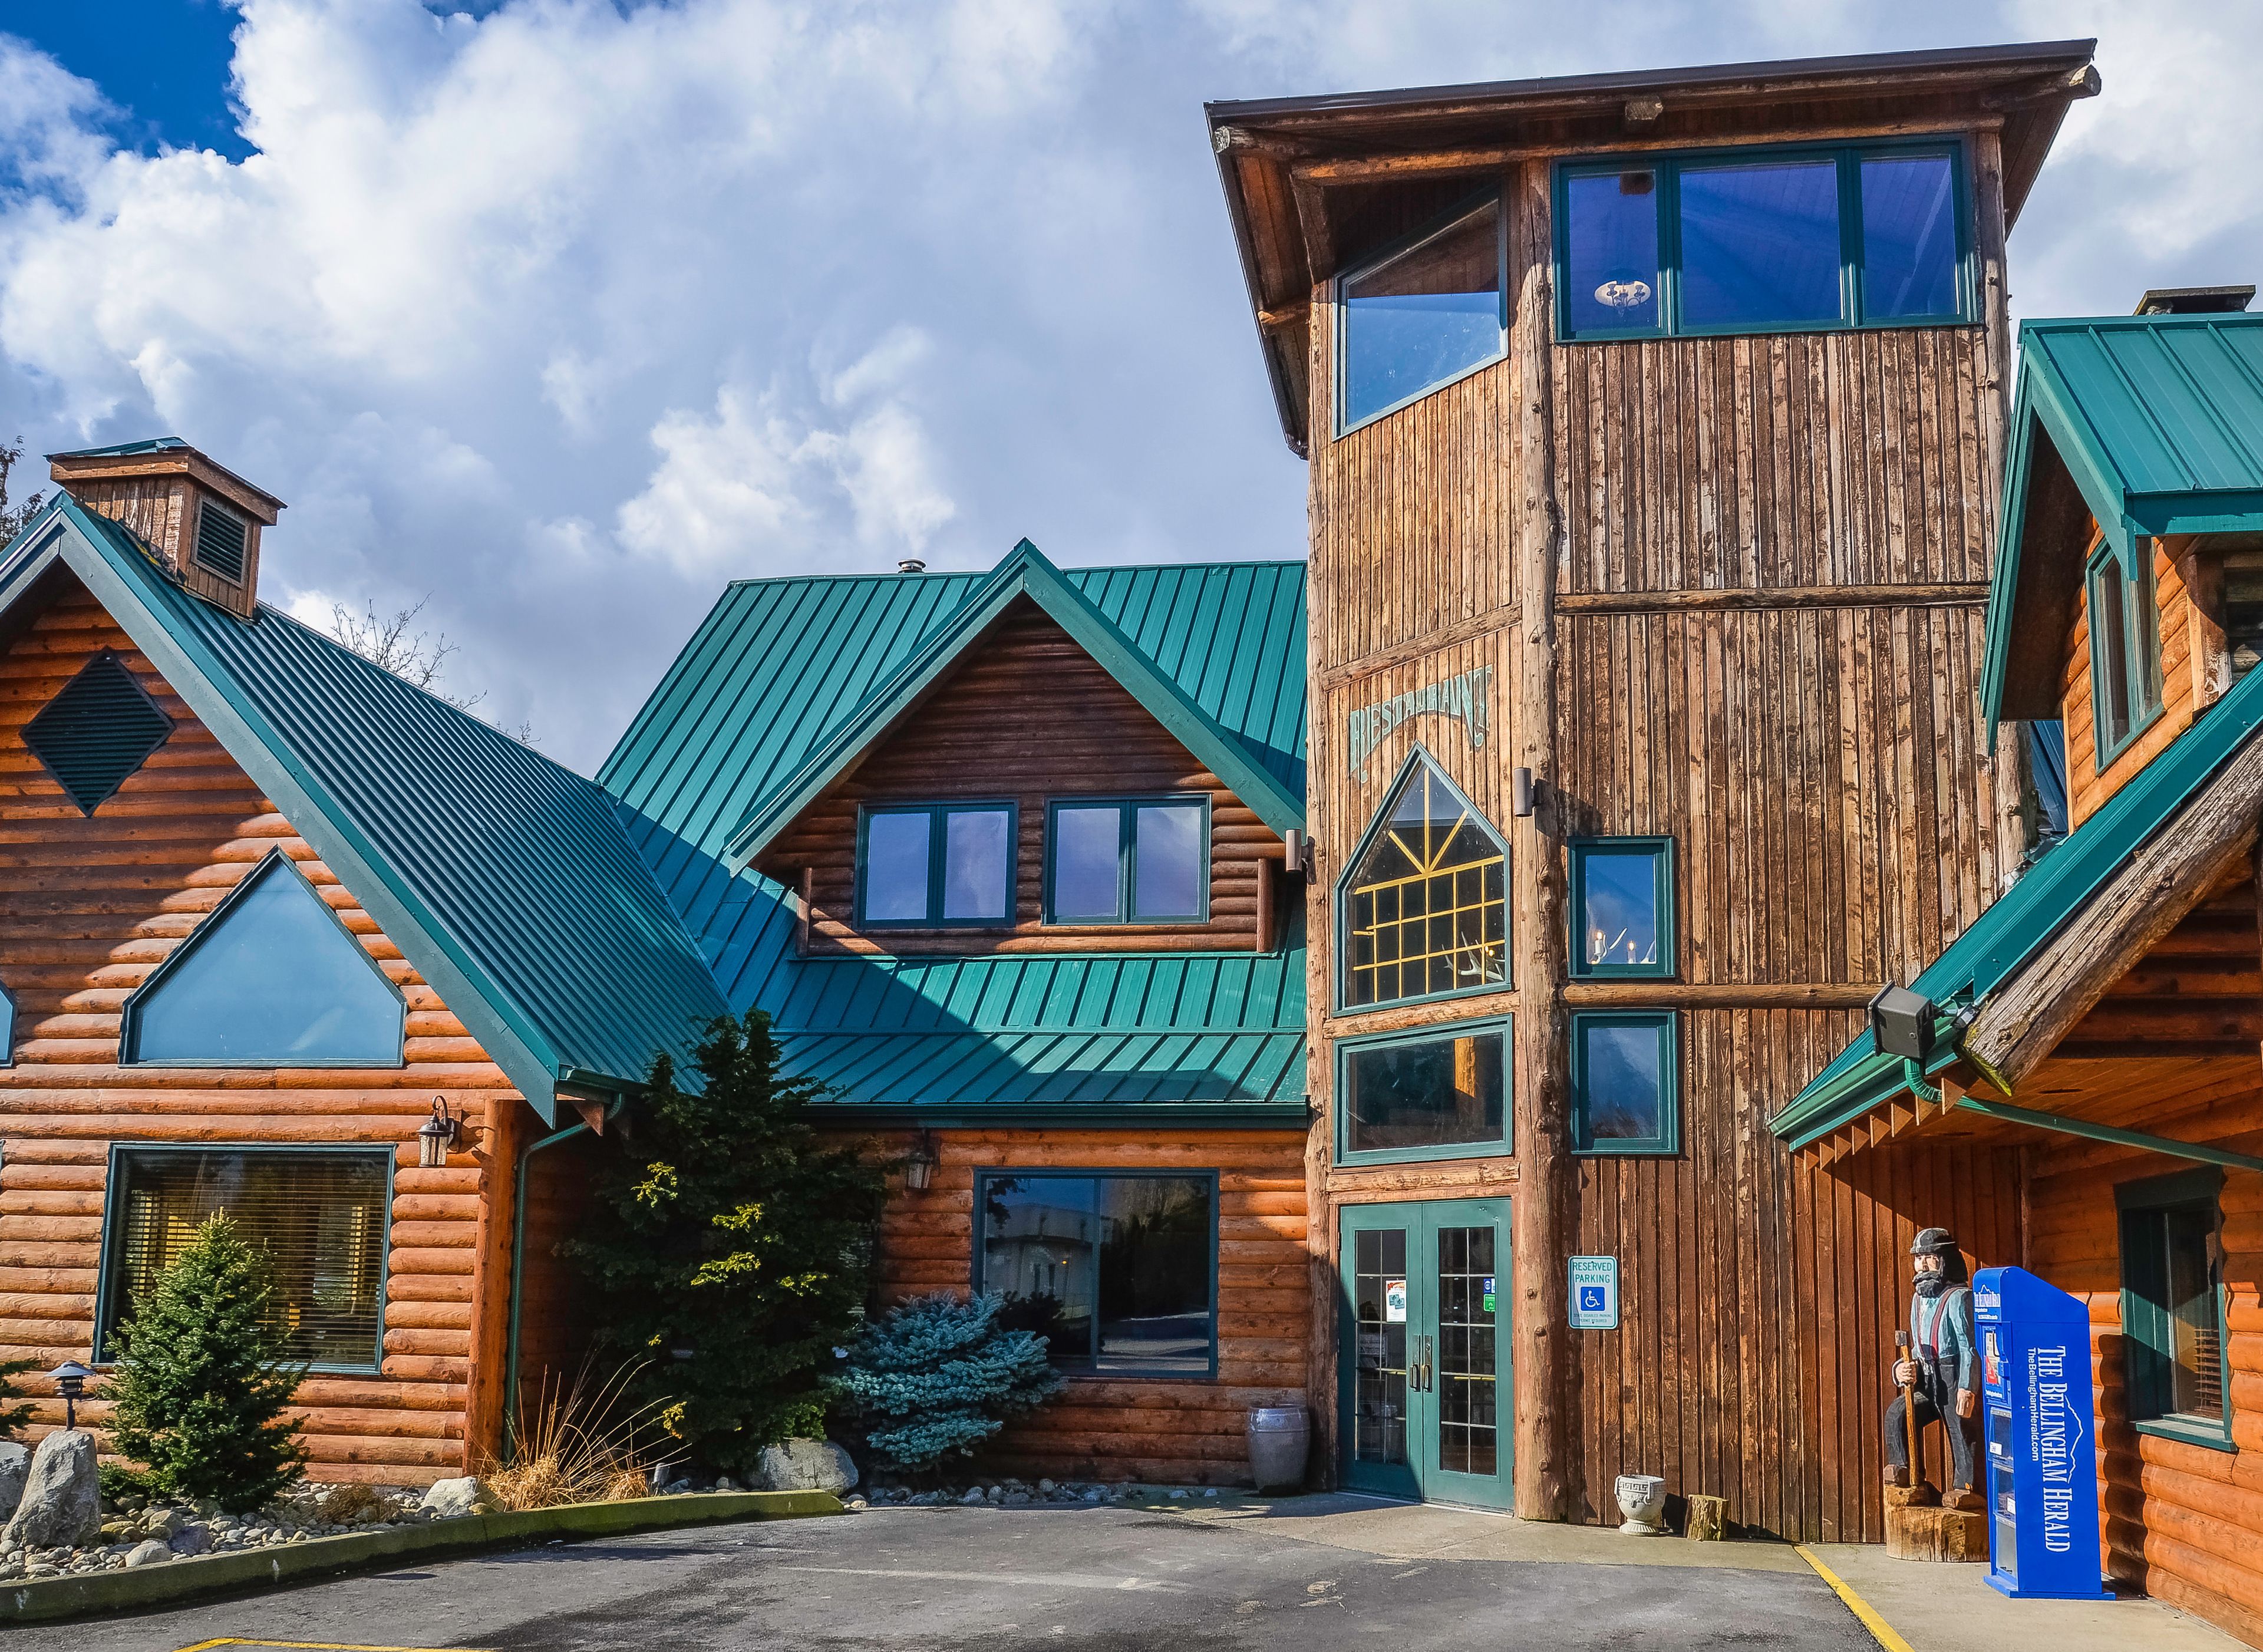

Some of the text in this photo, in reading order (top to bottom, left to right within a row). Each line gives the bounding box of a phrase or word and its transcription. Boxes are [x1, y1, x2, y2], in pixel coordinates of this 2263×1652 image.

[1349, 664, 1493, 784] RESTAURANT
[1573, 1262, 1612, 1271] RESERVED
[1575, 1274, 1611, 1283] PARKING
[2027, 1347, 2039, 1462] TheBellinghamHerald.com
[2037, 1346, 2073, 1552] THE BELLINGHAM HERALD
